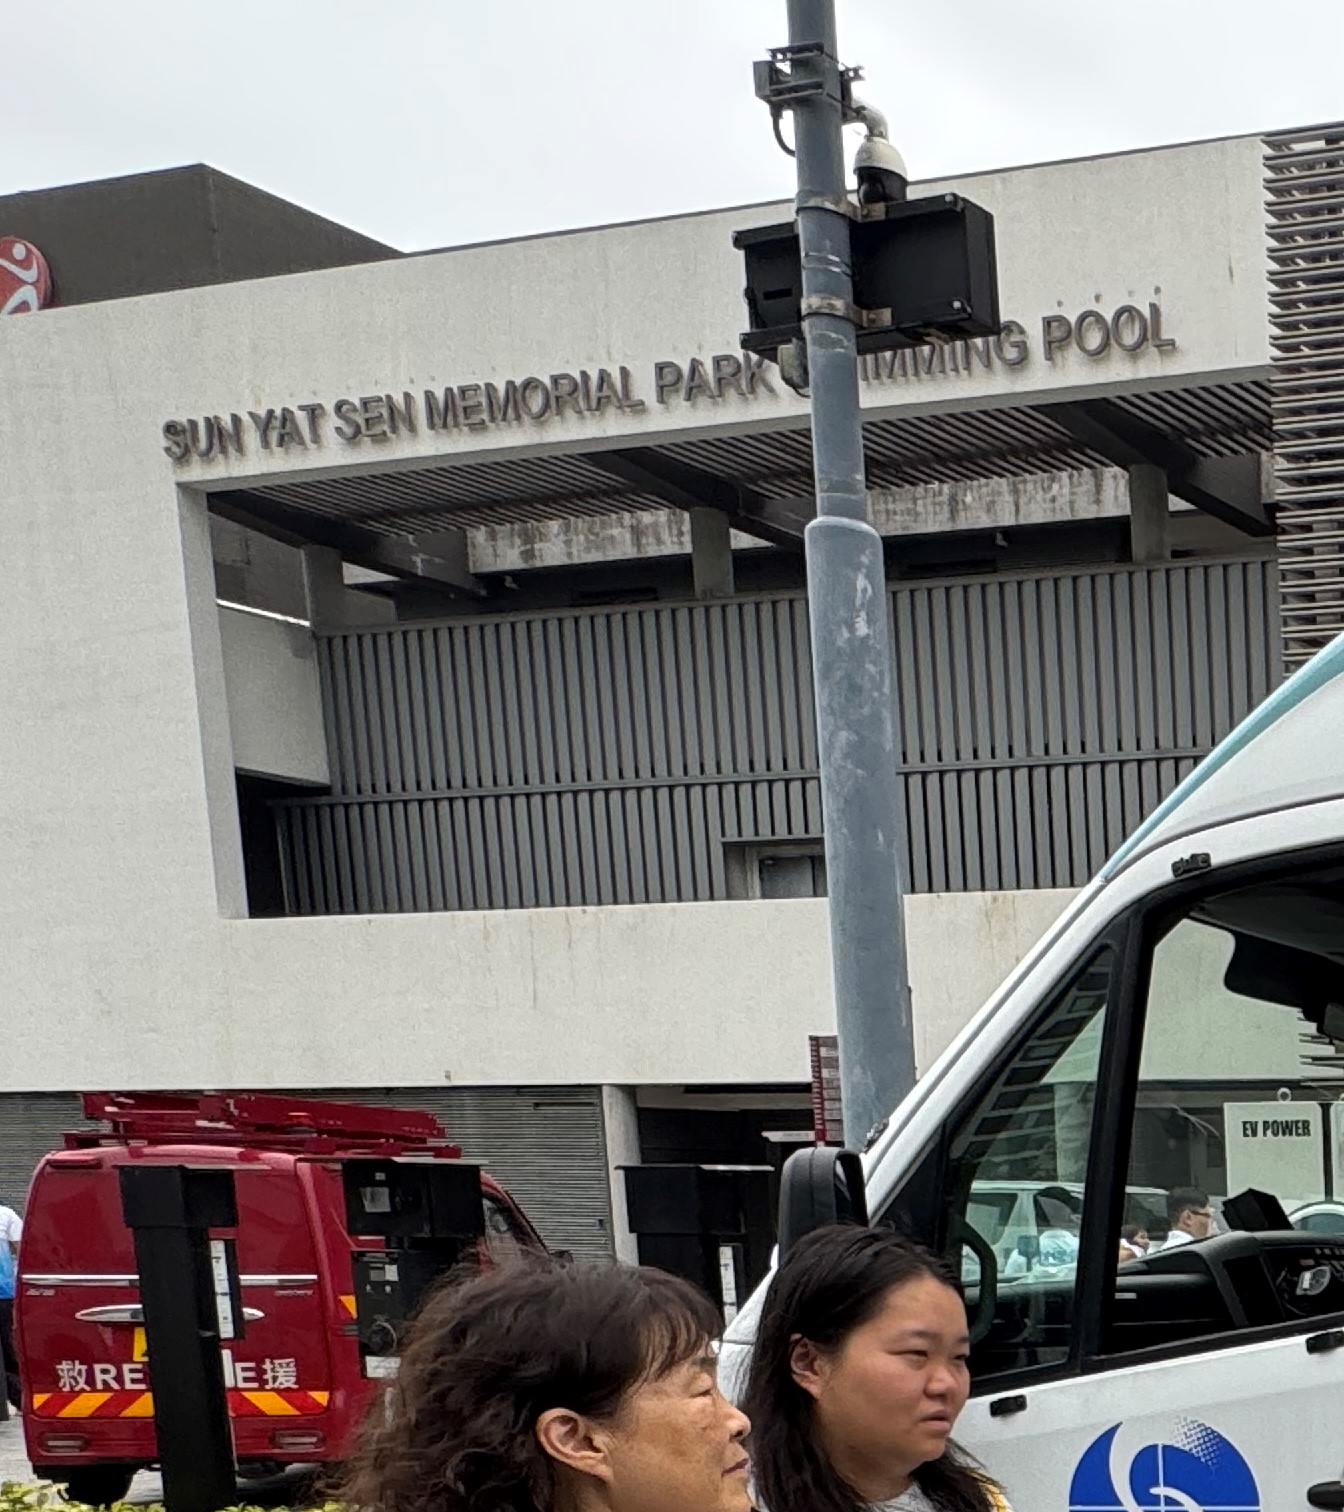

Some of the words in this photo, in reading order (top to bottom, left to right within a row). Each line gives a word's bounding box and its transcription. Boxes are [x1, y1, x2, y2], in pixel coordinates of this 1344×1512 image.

[163, 413, 244, 462] SUN
[248, 403, 324, 450] YAT
[334, 392, 417, 442] SEN
[424, 365, 645, 432] MEMORIAL
[655, 352, 776, 403] PARK
[1041, 302, 1176, 362] POOL
[1242, 1120, 1259, 1138] EV
[1262, 1119, 1312, 1138] POWER
